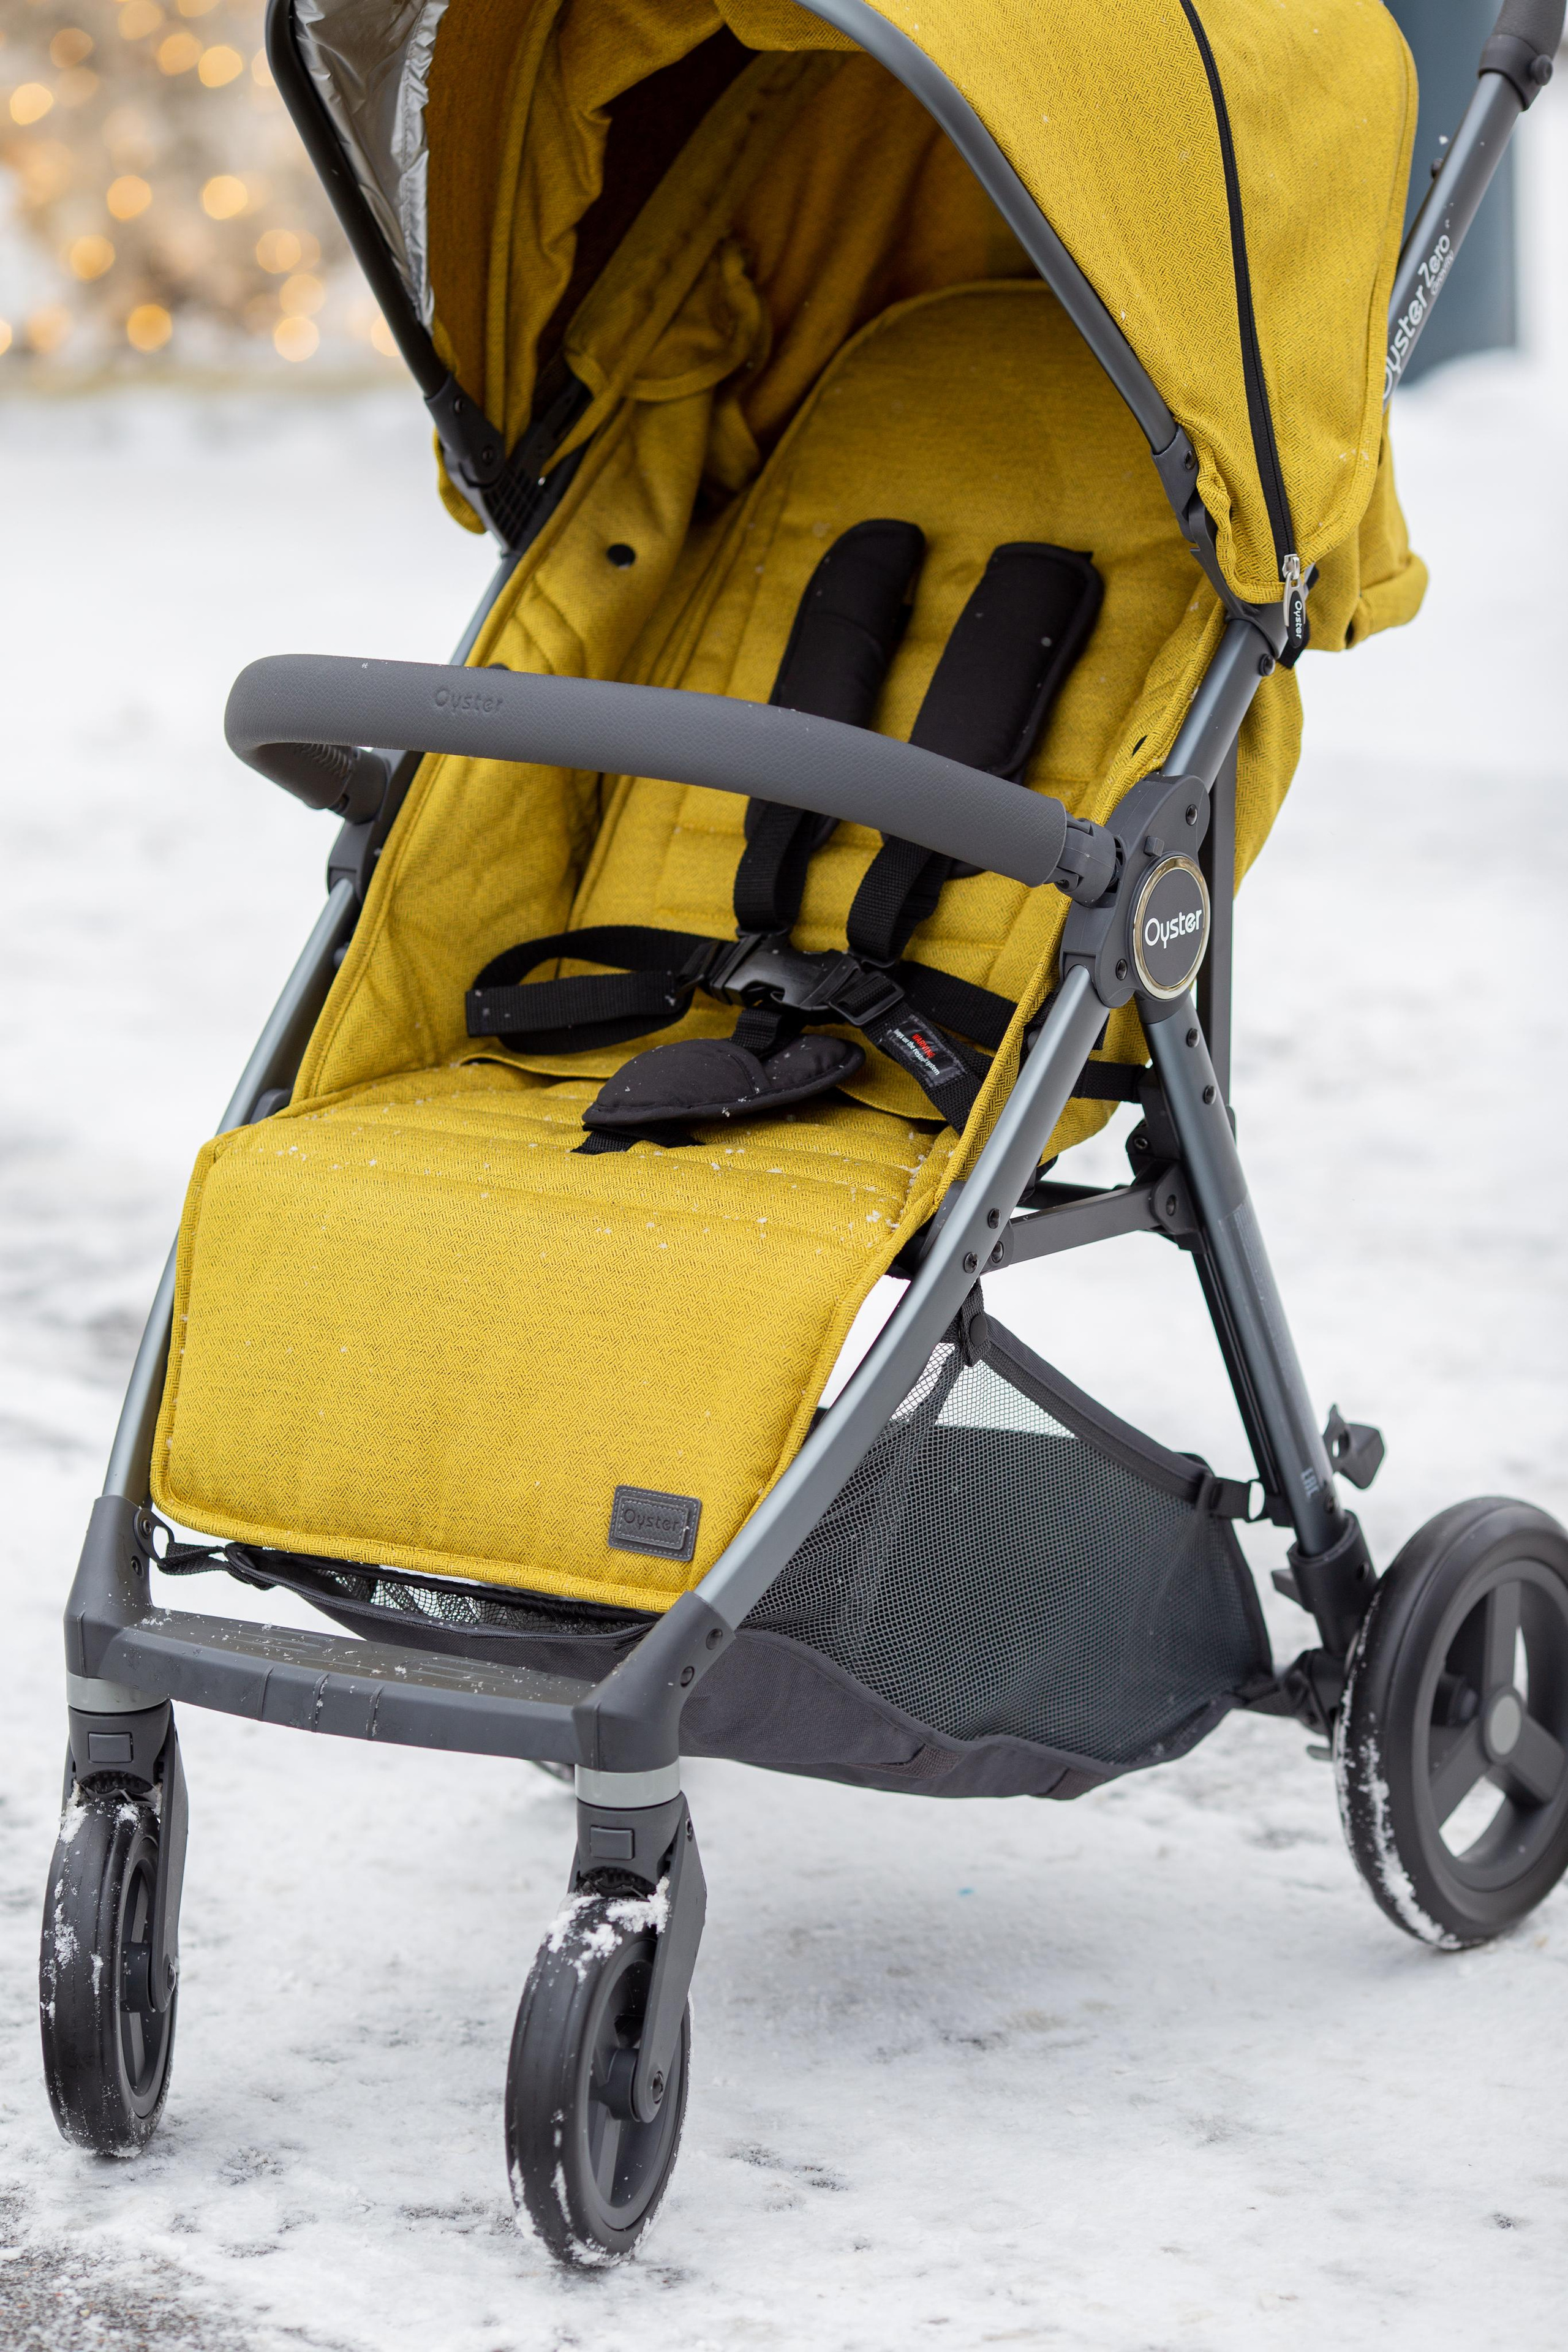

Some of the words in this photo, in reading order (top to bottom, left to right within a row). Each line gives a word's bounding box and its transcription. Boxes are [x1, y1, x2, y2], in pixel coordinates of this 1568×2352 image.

[1417, 235, 1450, 288] Zero
[1293, 600, 1303, 639] Oyster
[435, 685, 503, 715] Oyster
[1145, 910, 1202, 949] Oyster
[907, 1041, 916, 1050] the
[925, 1060, 940, 1076] system
[911, 1033, 936, 1059] WARNING
[624, 1508, 680, 1532] Oyster
